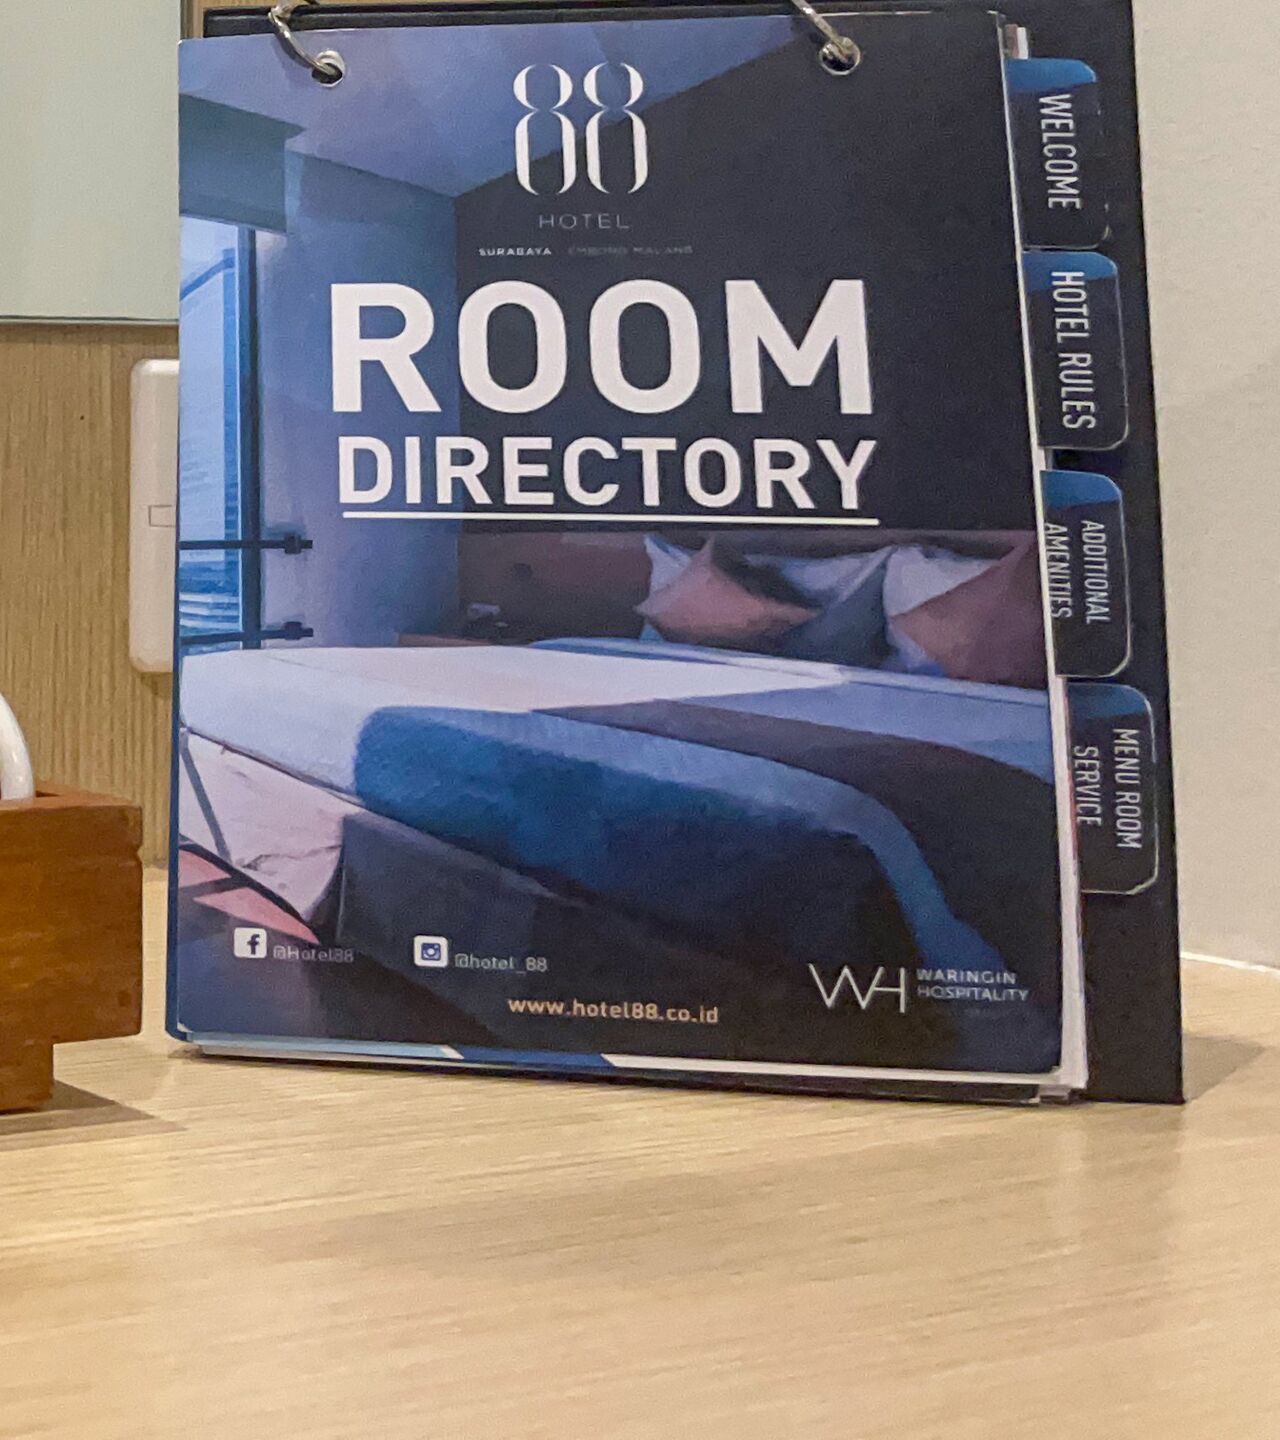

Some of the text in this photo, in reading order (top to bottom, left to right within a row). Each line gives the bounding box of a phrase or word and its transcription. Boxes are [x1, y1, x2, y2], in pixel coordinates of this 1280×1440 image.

[513, 61, 648, 196] 88
[1039, 93, 1082, 211] WELCOME
[479, 247, 552, 257] SURABAYA
[538, 213, 630, 229] HOTEL
[330, 278, 875, 416] ROOM
[1051, 271, 1096, 430] HOTEL RULES
[337, 436, 877, 509] DIRECTORY
[1045, 522, 1072, 618] AMENITIES
[1081, 520, 1111, 624] ADDITIONAL
[1074, 746, 1101, 826] SERVICE
[1113, 728, 1142, 848] MENU ROOM
[508, 998, 718, 1024] www.hotel88.co.id
[917, 969, 1016, 984] WARINGIN
[917, 986, 1029, 1001] HOSPITALITY
